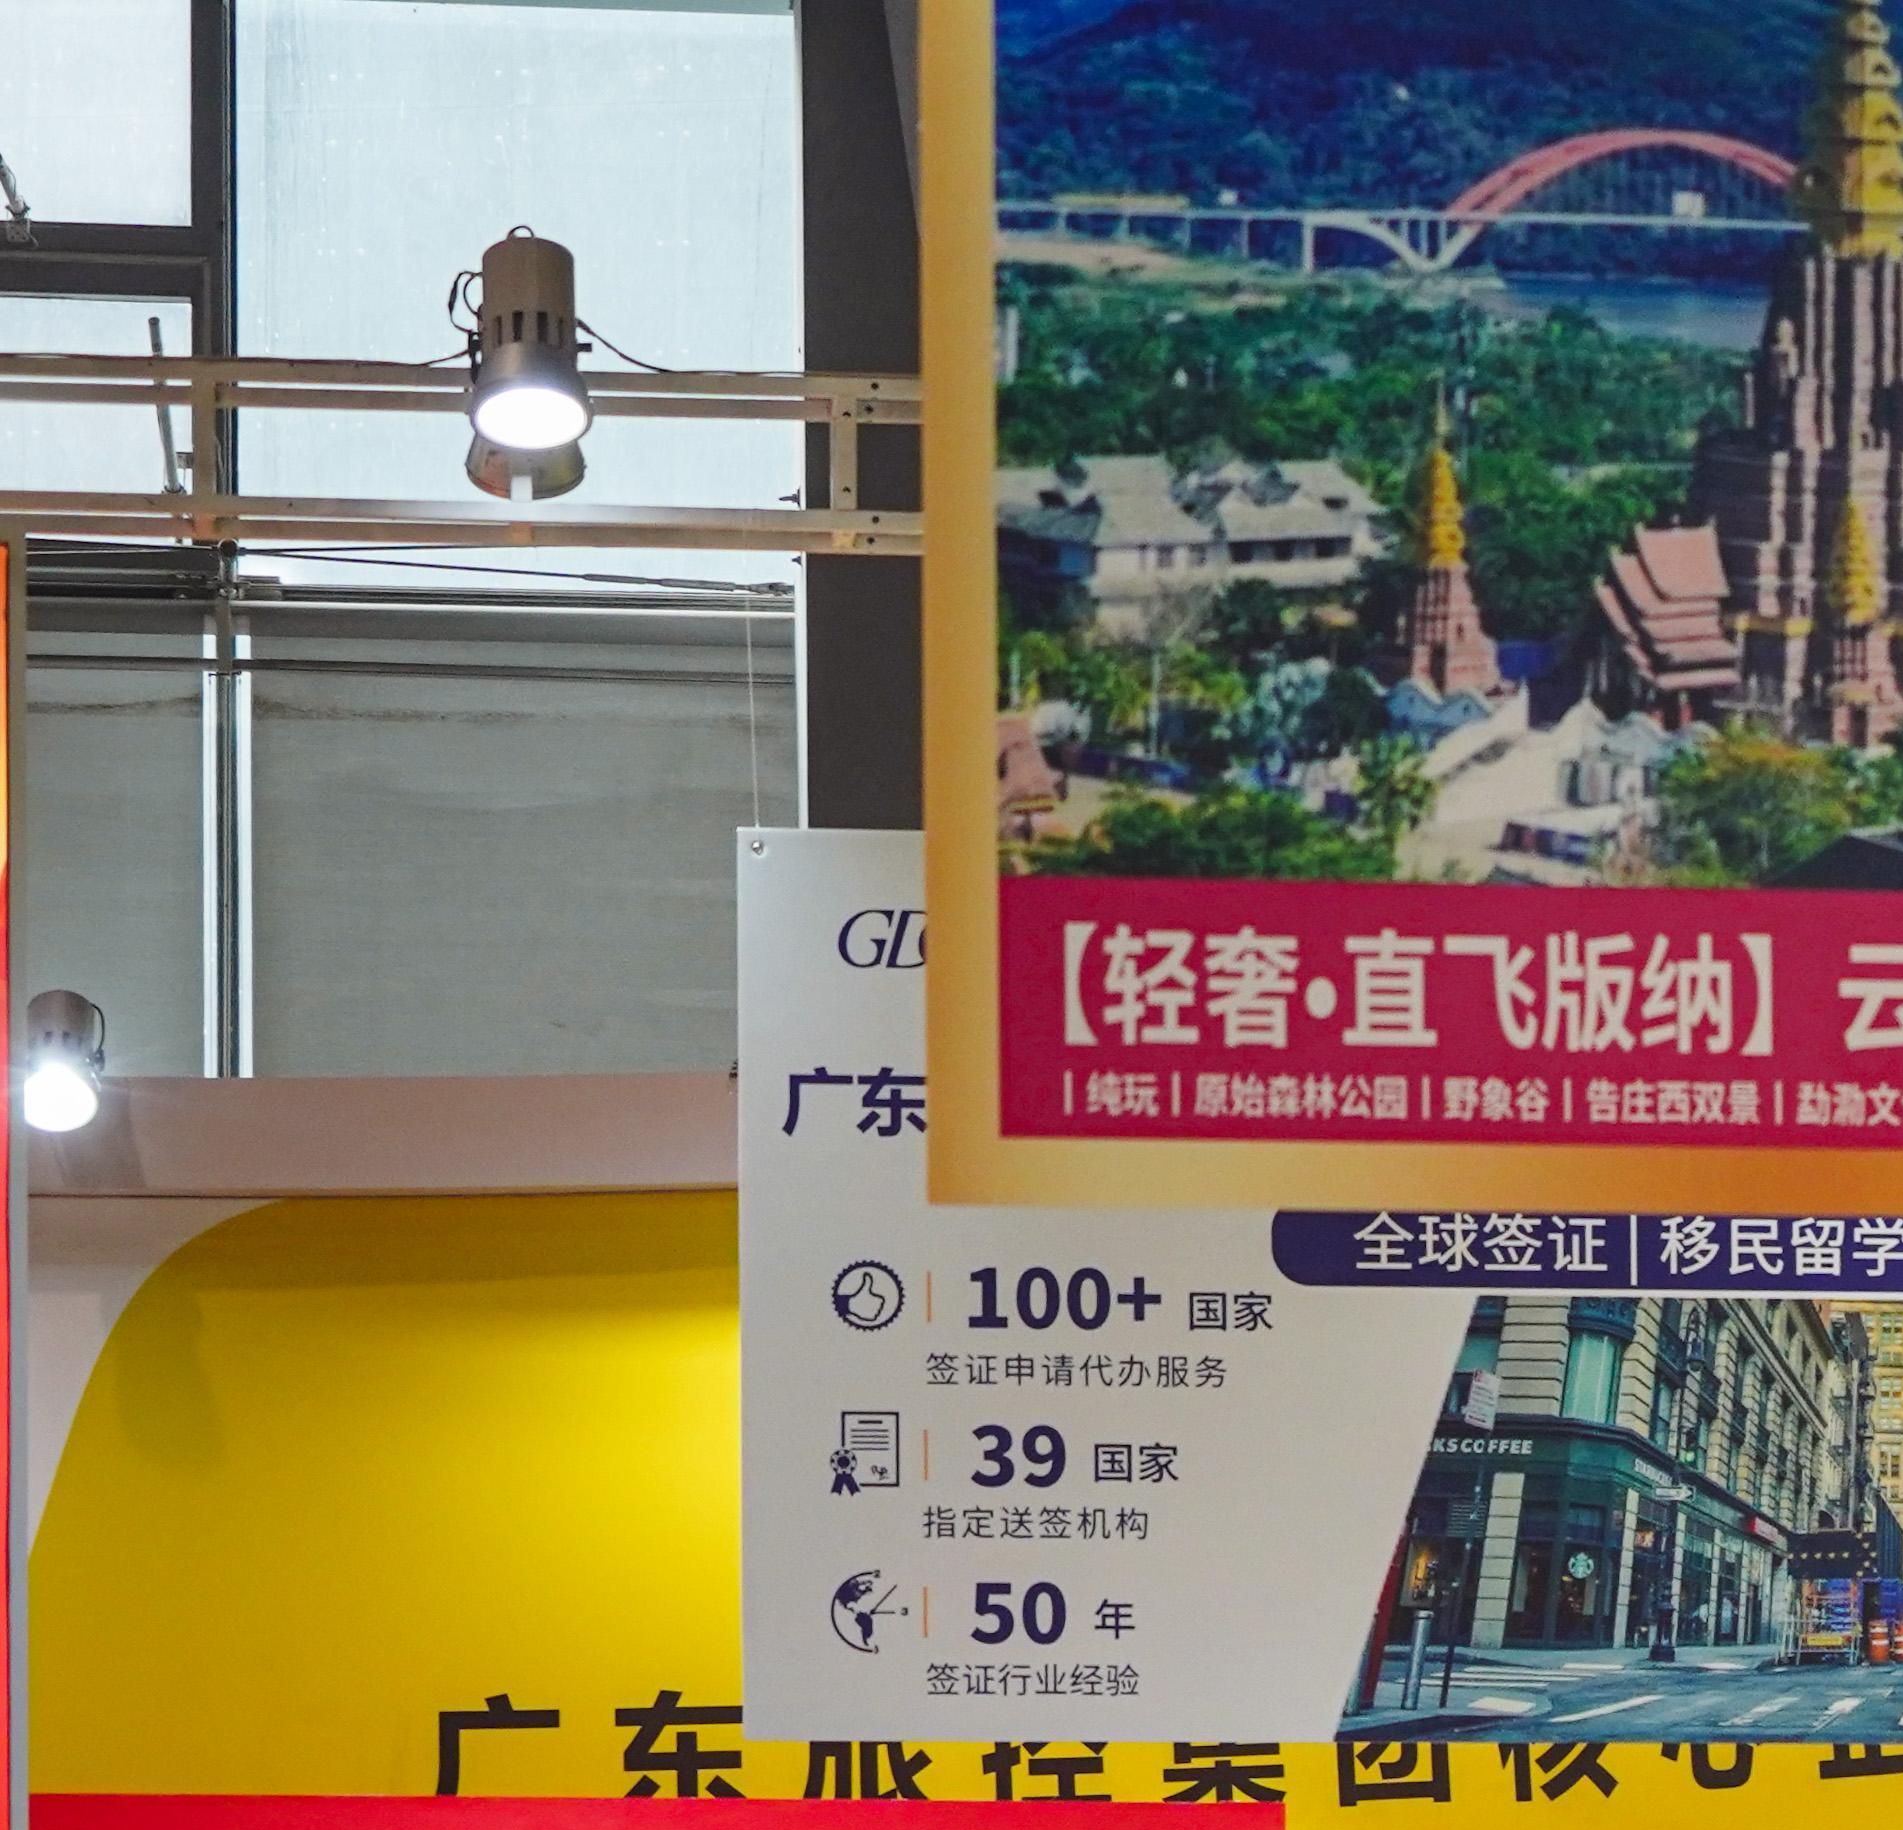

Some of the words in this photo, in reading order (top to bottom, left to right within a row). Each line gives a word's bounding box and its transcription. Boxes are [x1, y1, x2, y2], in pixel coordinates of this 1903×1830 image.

[837, 907, 928, 969] GD
[1085, 1071, 1160, 1119] 纯玩
[1194, 1073, 1408, 1121] 原始森林公园
[1442, 1076, 1551, 1123] 野象谷
[1586, 1079, 1760, 1126] 告庄西双景
[1352, 1212, 1608, 1274] 全球签证
[966, 1266, 1162, 1330] 100+
[1188, 1291, 1274, 1332] 国家
[925, 1353, 1228, 1390] 签证申请代办服务
[971, 1424, 1067, 1487] 39
[1093, 1442, 1179, 1484] 国家
[922, 1506, 1149, 1541] 指定送签机构
[971, 1581, 1067, 1645] 50
[1094, 1598, 1137, 1640] 年
[925, 1663, 1141, 1698] 签证行业经验
